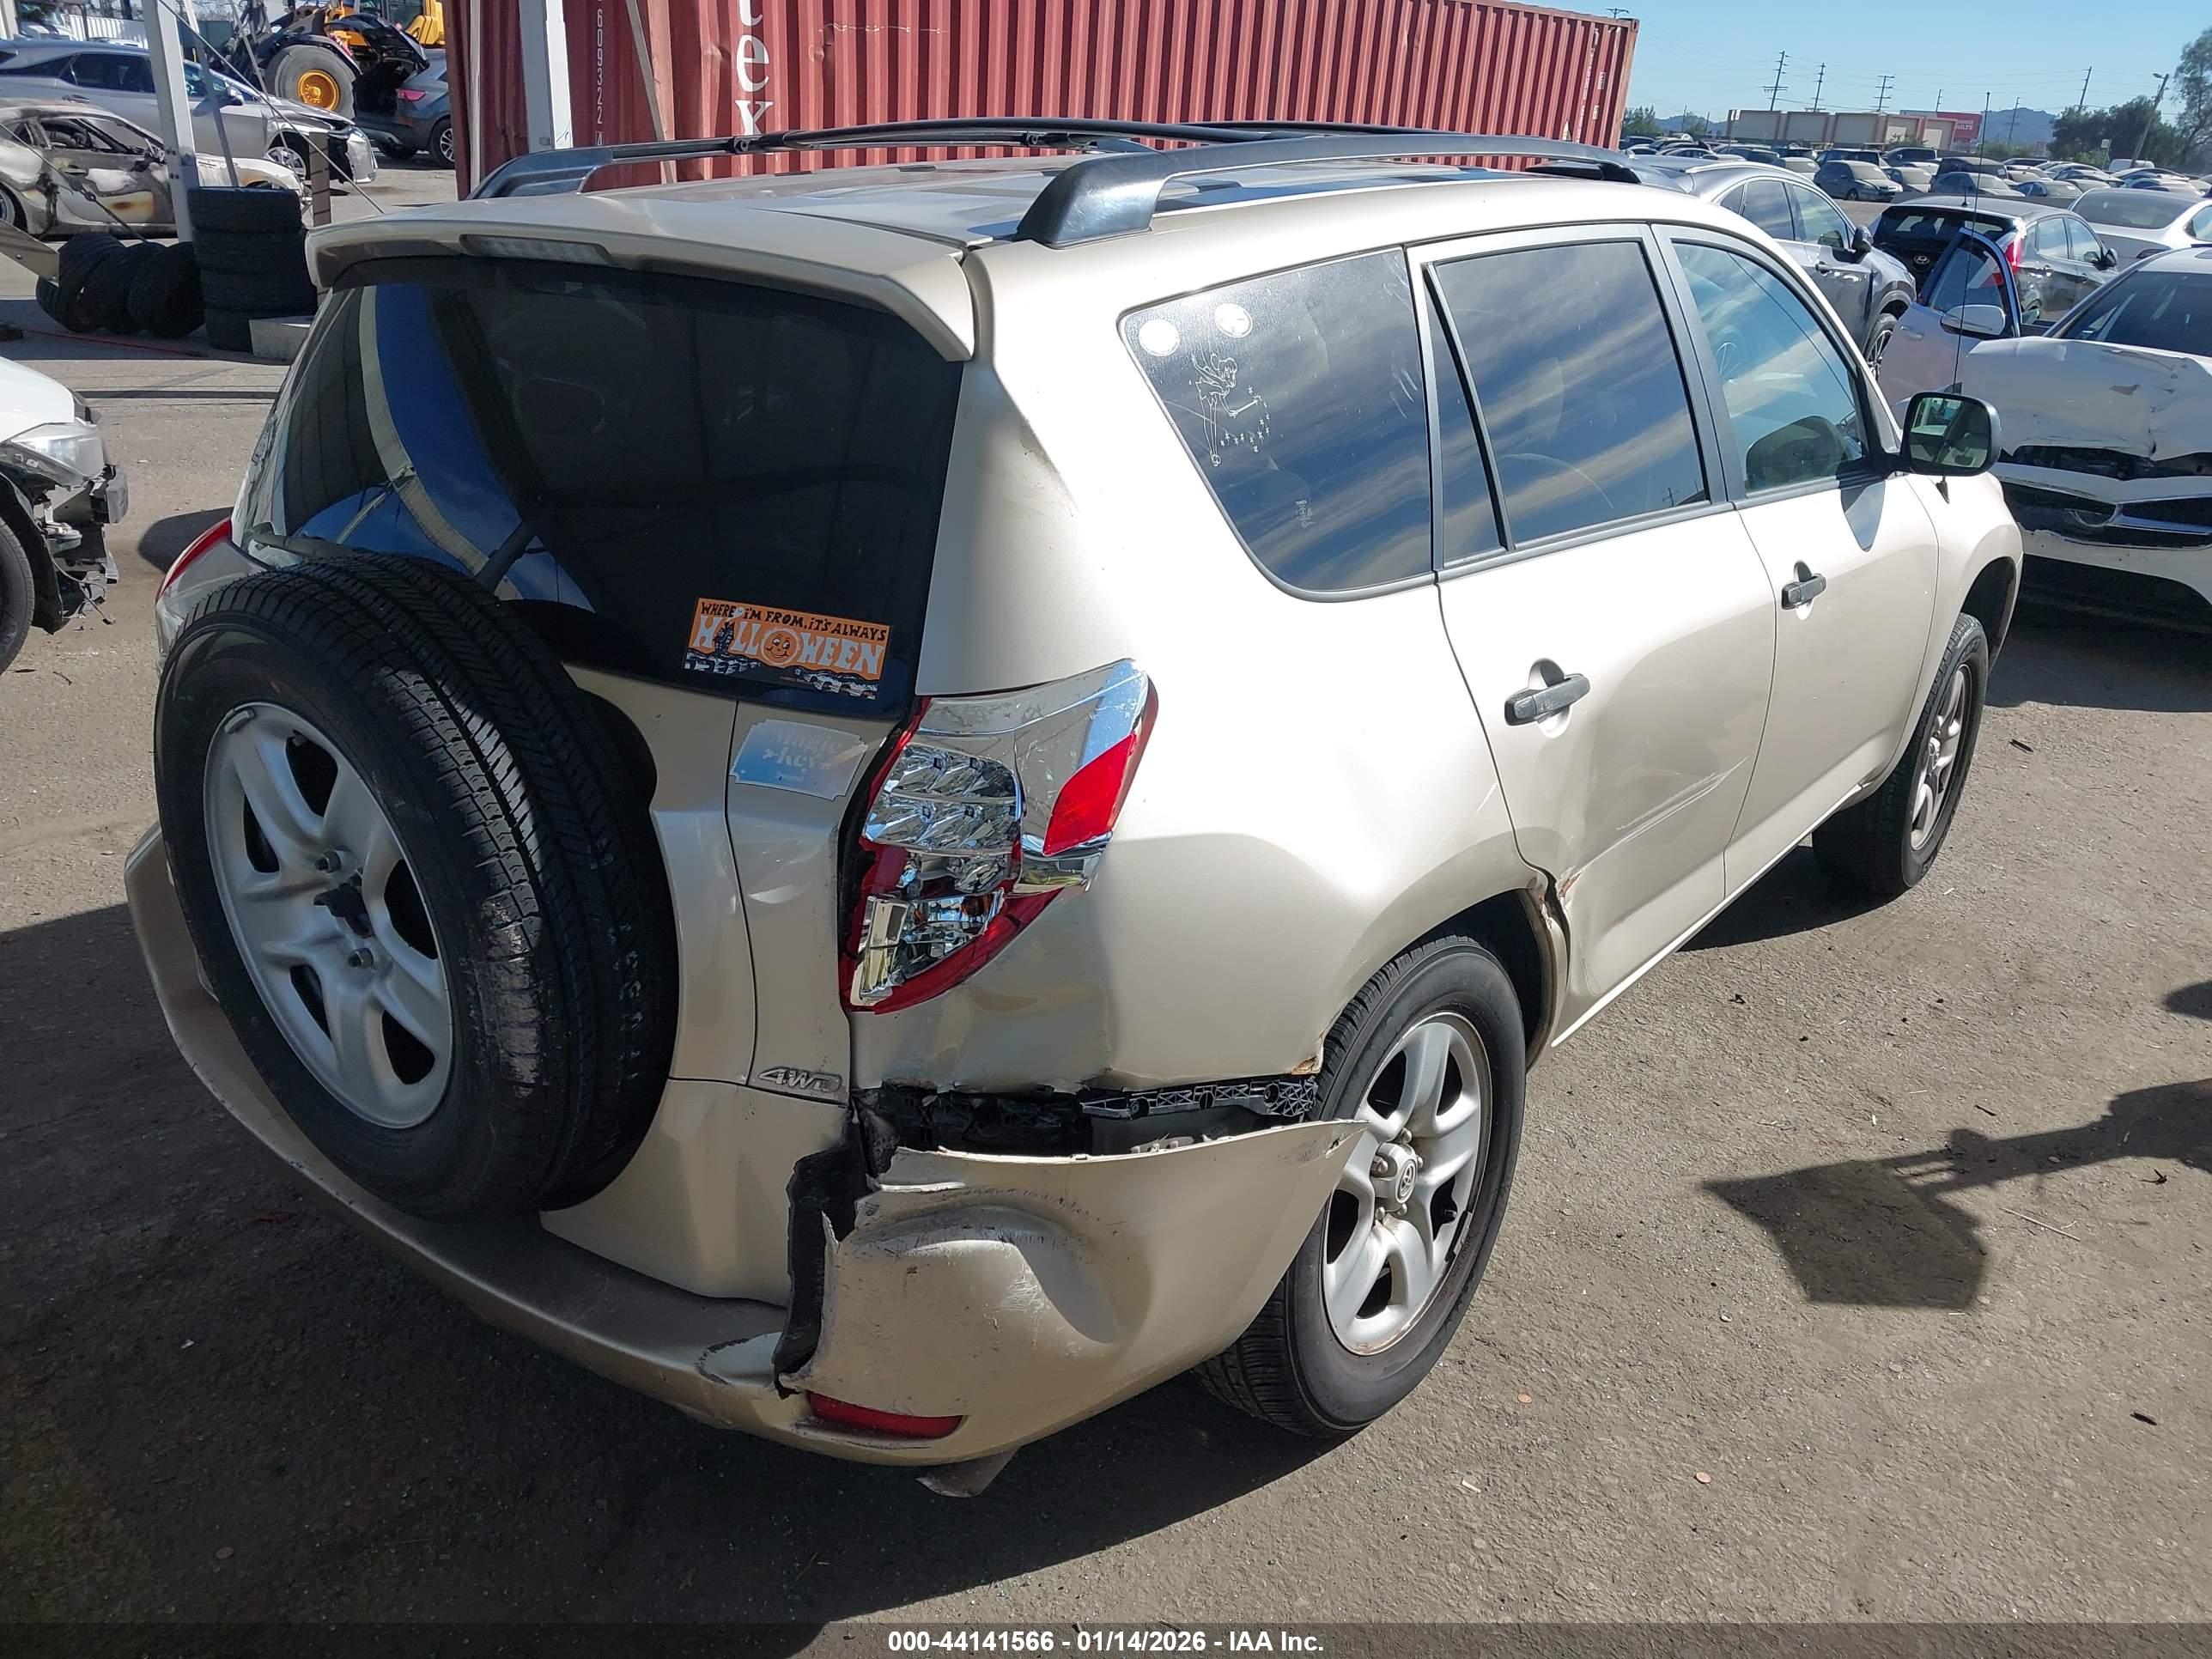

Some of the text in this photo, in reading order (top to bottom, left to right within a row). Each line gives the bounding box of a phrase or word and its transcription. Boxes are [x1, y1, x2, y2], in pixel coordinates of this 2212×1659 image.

[701, 602, 736, 618] WHERE
[831, 623, 887, 641] ALWAYS
[758, 1066, 842, 1092] 4WD
